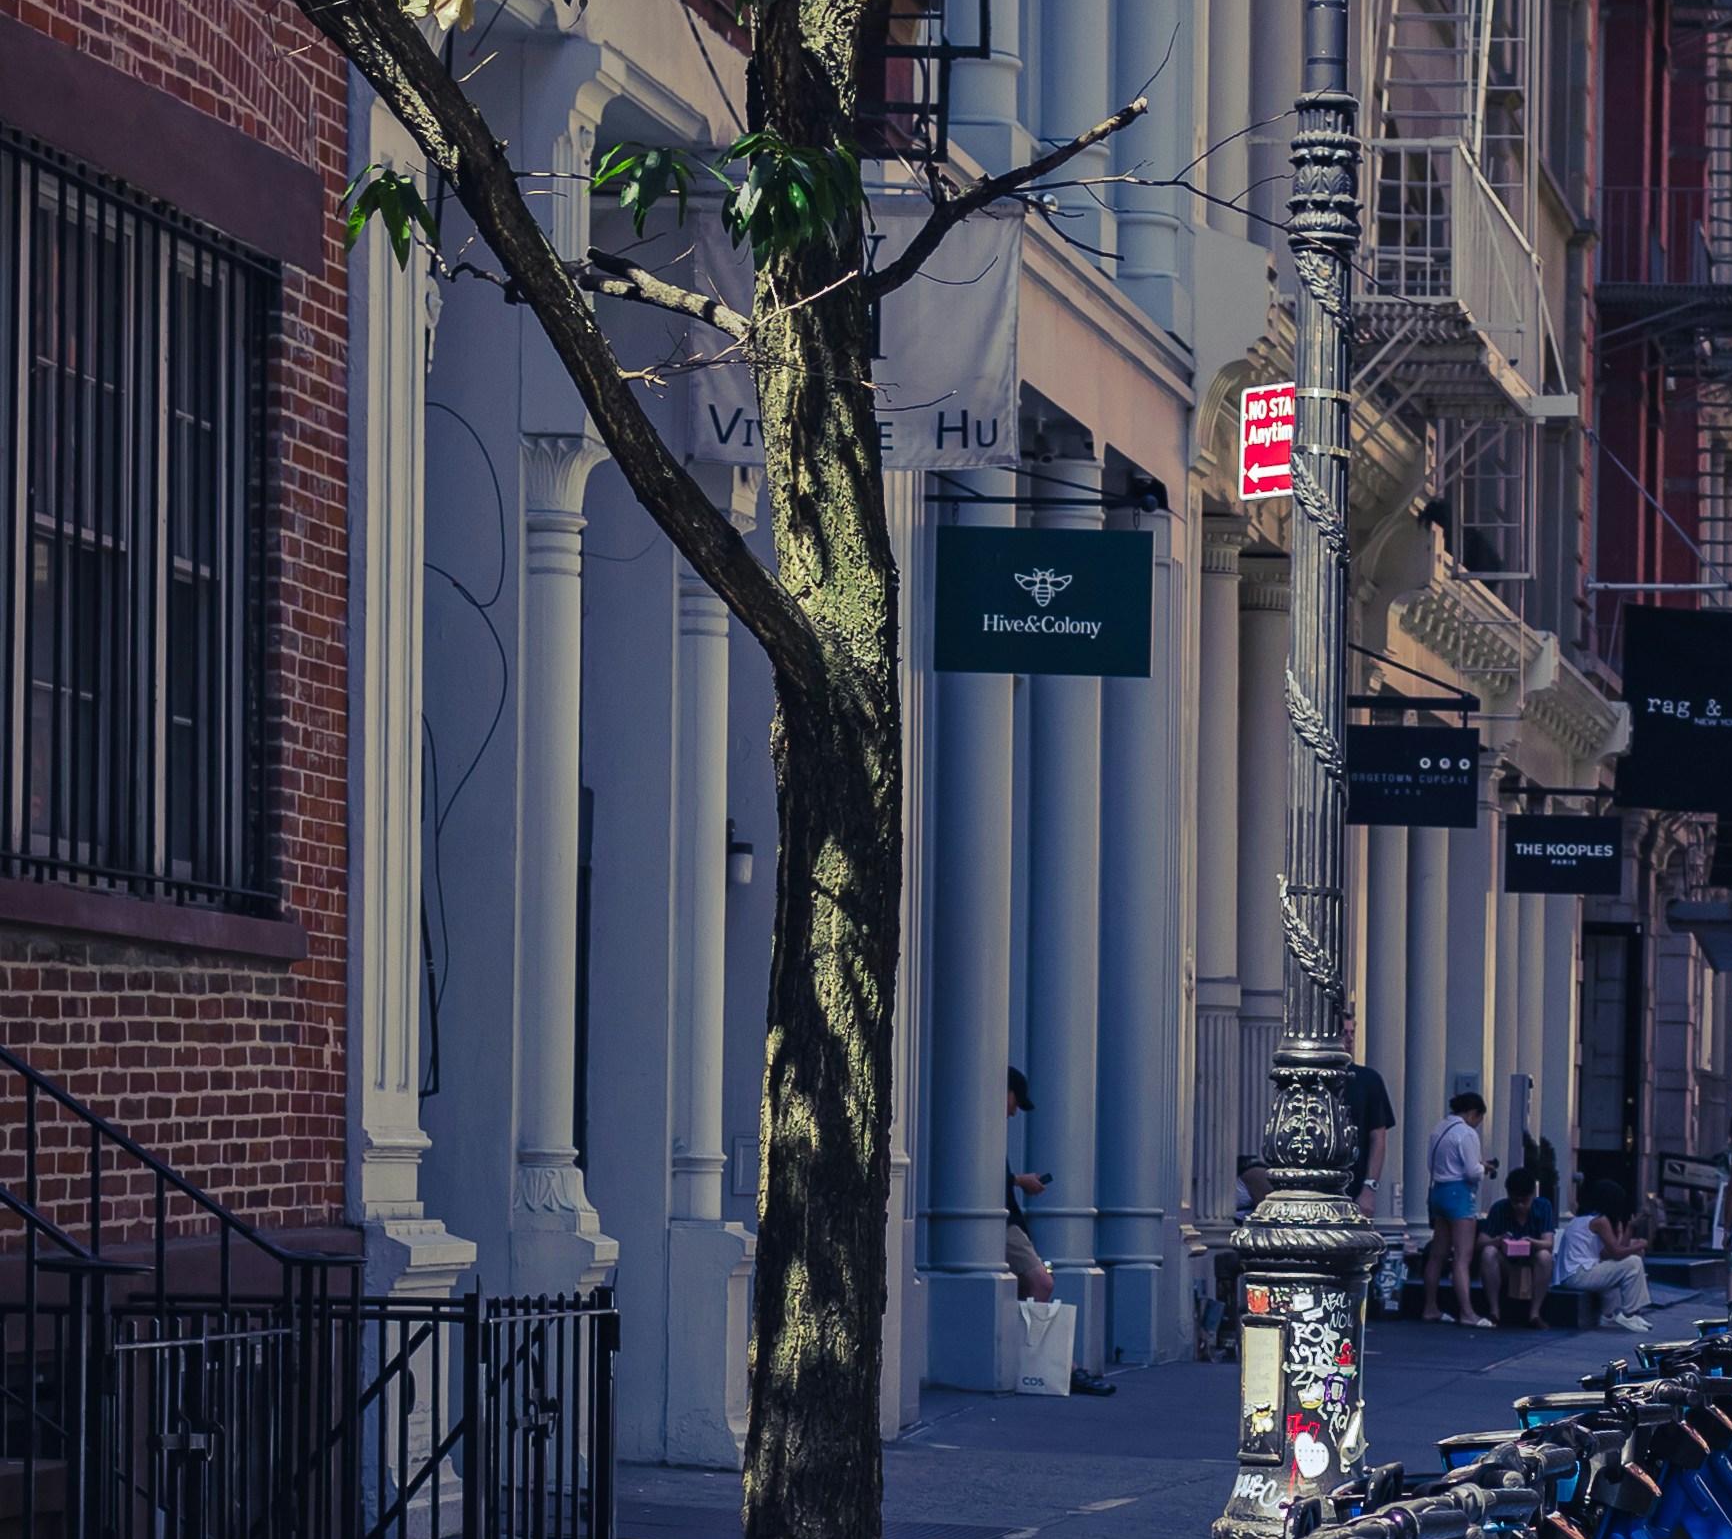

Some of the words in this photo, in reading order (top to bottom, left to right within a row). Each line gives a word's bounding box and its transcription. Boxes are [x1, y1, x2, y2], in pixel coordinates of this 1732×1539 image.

[1248, 399, 1268, 421] NO
[1269, 396, 1295, 419] STA
[1248, 421, 1294, 448] Anytim
[982, 613, 1102, 639] Hive&Colony
[1647, 698, 1691, 719] rag
[1705, 698, 1722, 718] &
[1515, 842, 1543, 856] THE
[1546, 842, 1613, 858] KOOPLES
[1022, 1376, 1045, 1387] COS
